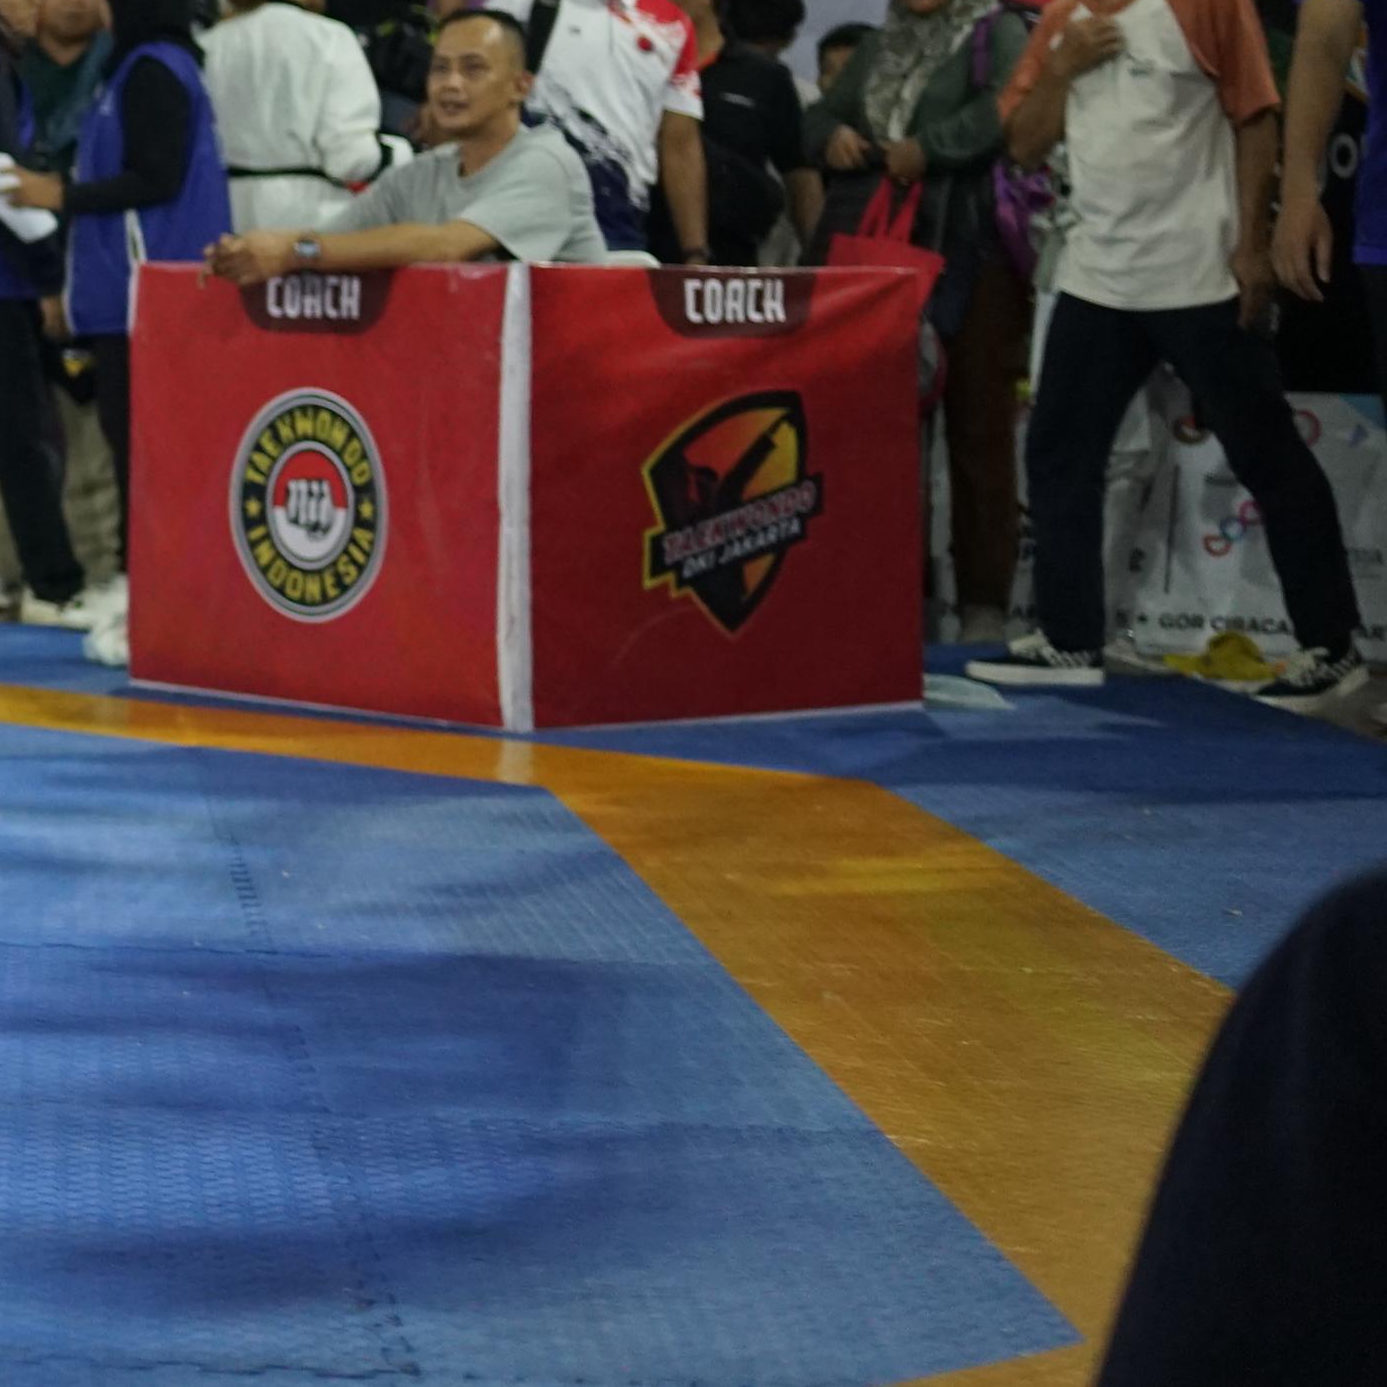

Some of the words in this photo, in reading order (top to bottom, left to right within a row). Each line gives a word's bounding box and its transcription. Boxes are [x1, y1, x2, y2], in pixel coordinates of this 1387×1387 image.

[266, 275, 361, 319] COACH
[684, 278, 786, 324] COACH
[245, 407, 371, 485] TAEKWONDO
[247, 525, 375, 603] INDONESIA
[719, 515, 802, 564] JAKARTA
